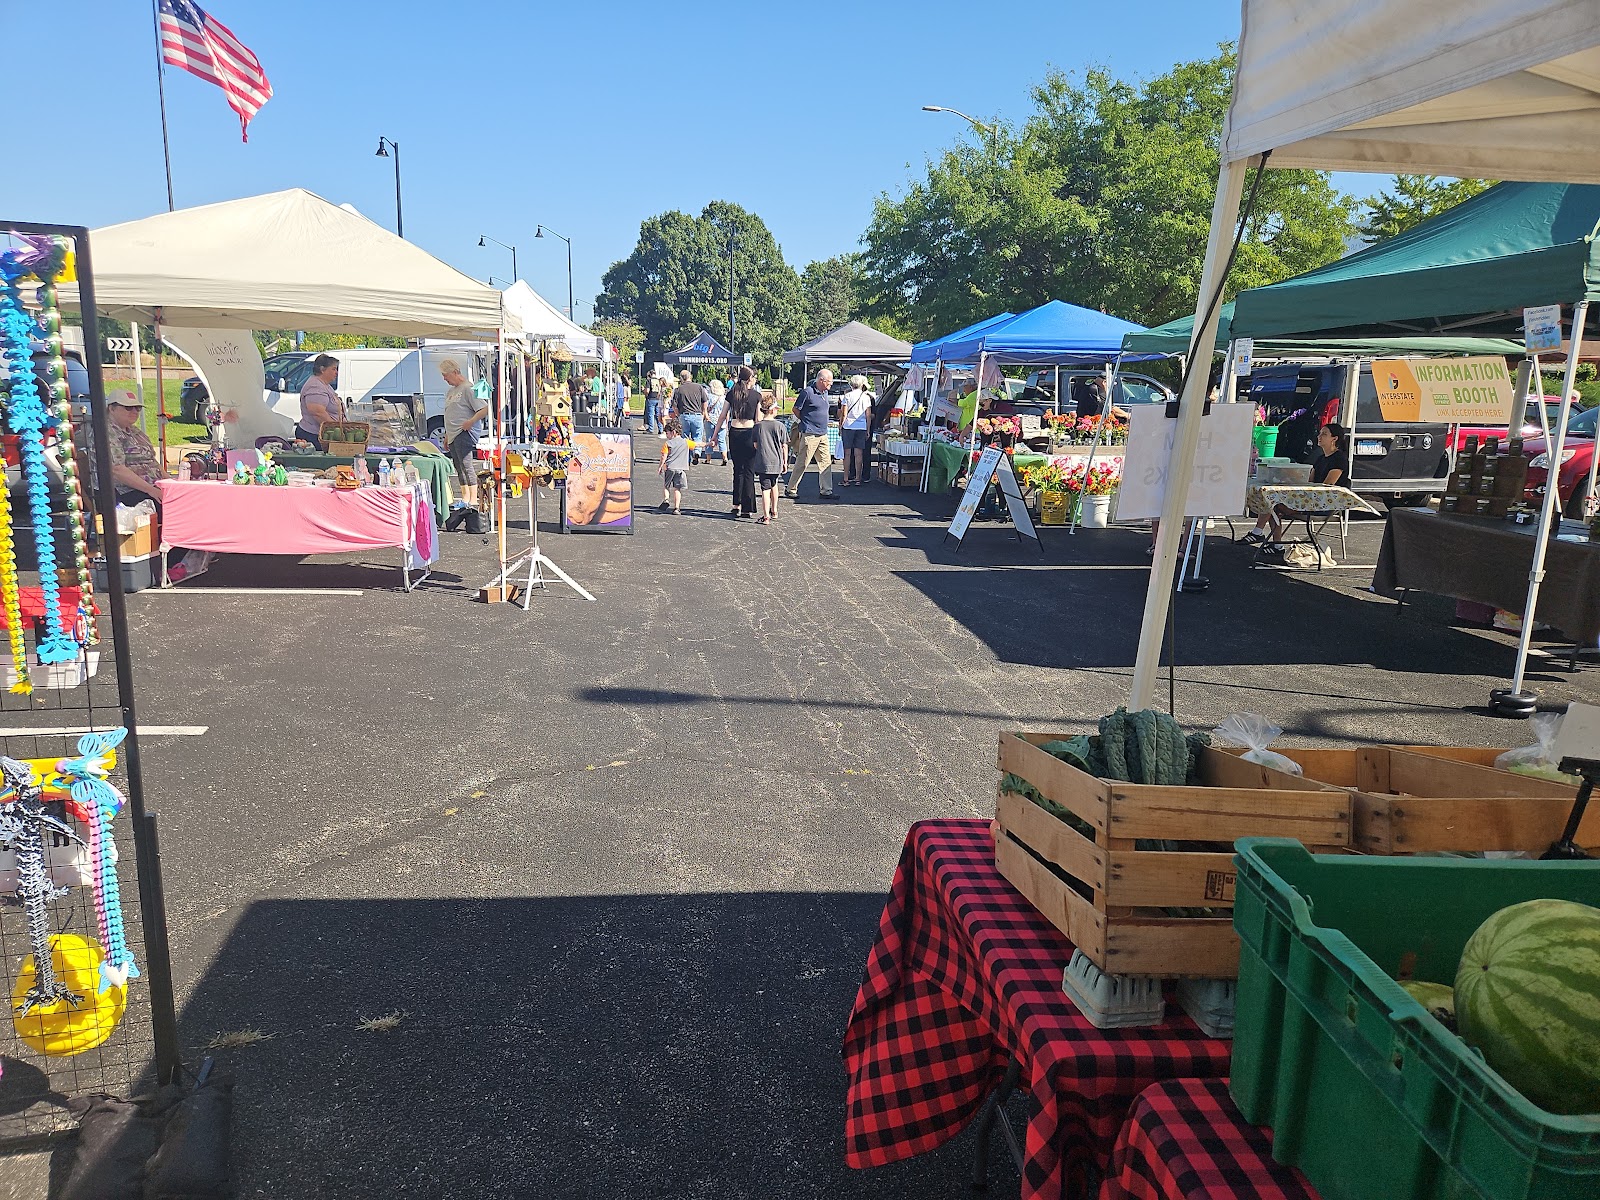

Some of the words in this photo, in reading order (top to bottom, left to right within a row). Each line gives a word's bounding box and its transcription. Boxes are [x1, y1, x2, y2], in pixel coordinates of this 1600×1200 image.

[1415, 362, 1505, 382] INFORMATION
[1380, 392, 1415, 400] INTERSTATE
[1452, 386, 1499, 404] BOOTH
[1436, 409, 1450, 417] LINK
[1451, 408, 1484, 417] ACCEPTED
